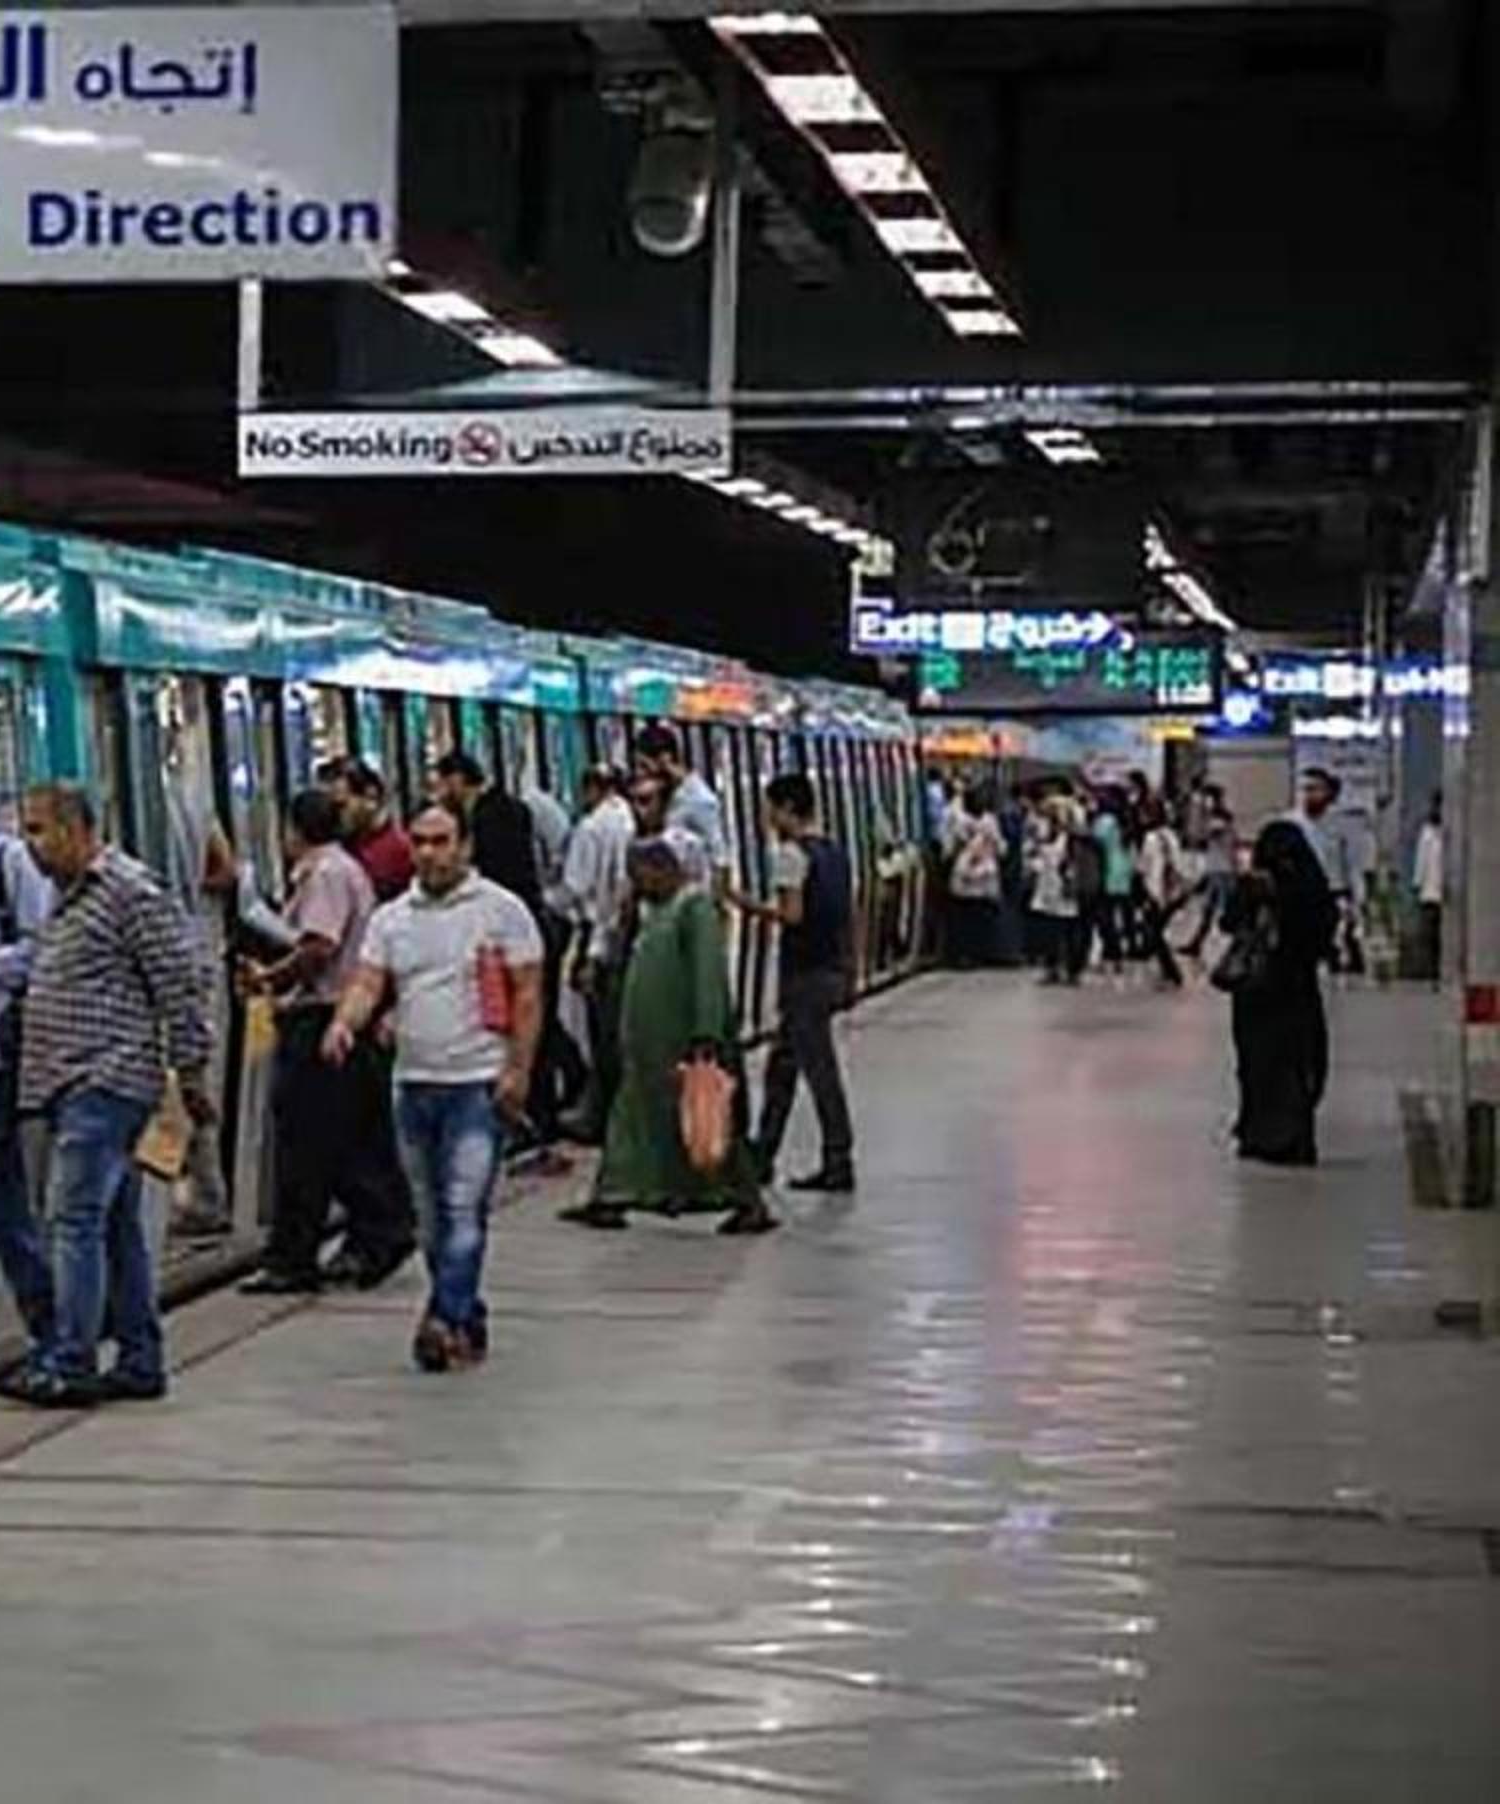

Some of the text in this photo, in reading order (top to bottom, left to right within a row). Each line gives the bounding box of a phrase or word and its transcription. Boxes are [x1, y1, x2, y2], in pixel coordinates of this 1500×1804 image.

[73, 40, 259, 116] إتجاه
[27, 188, 381, 248] Direction
[245, 428, 454, 465] No Smoking
